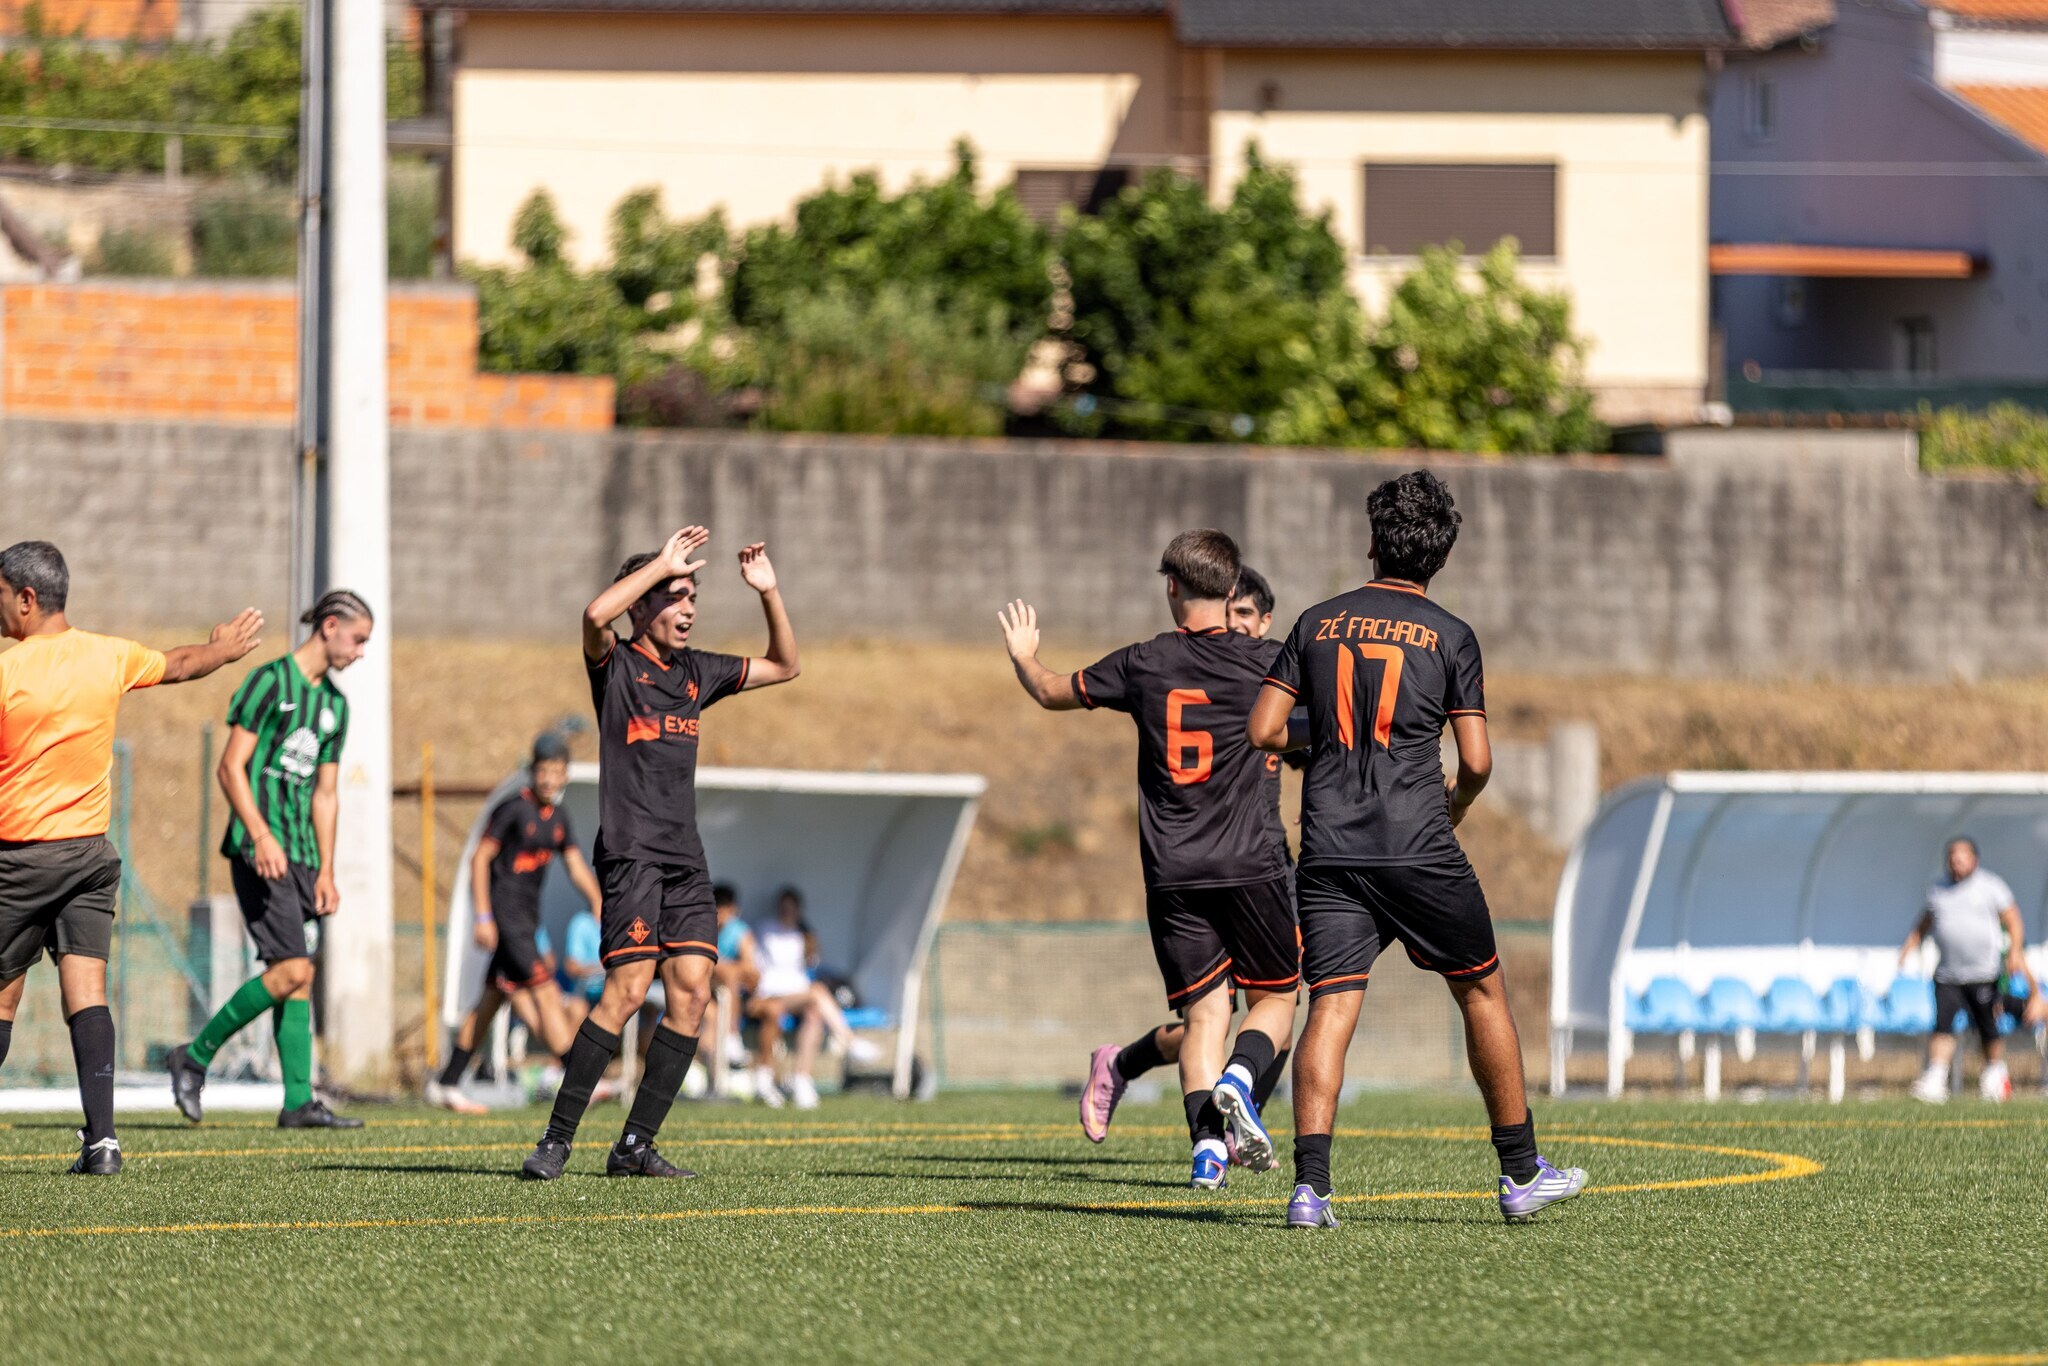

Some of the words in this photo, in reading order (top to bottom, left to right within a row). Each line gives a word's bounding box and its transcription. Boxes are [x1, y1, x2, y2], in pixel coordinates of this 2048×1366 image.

[1315, 609, 1348, 640] ZÉ
[1166, 688, 1214, 785] 6
[1337, 642, 1404, 750] 17
